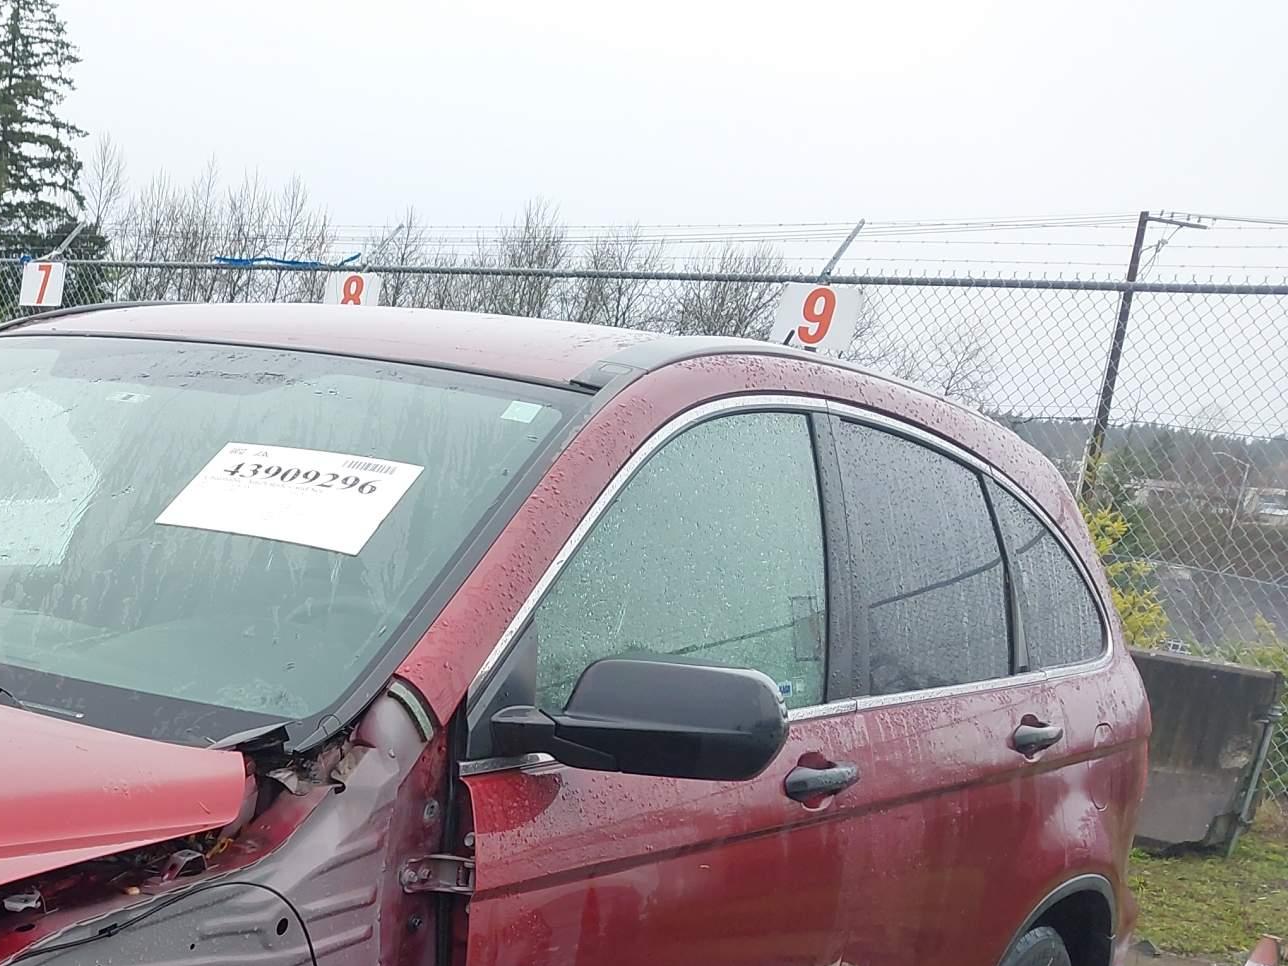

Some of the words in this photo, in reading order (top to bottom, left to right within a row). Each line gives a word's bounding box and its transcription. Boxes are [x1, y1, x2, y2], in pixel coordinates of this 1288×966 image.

[36, 264, 53, 305] 7
[340, 275, 365, 306] 8
[797, 287, 836, 345] 9
[223, 461, 383, 496] 43909296
